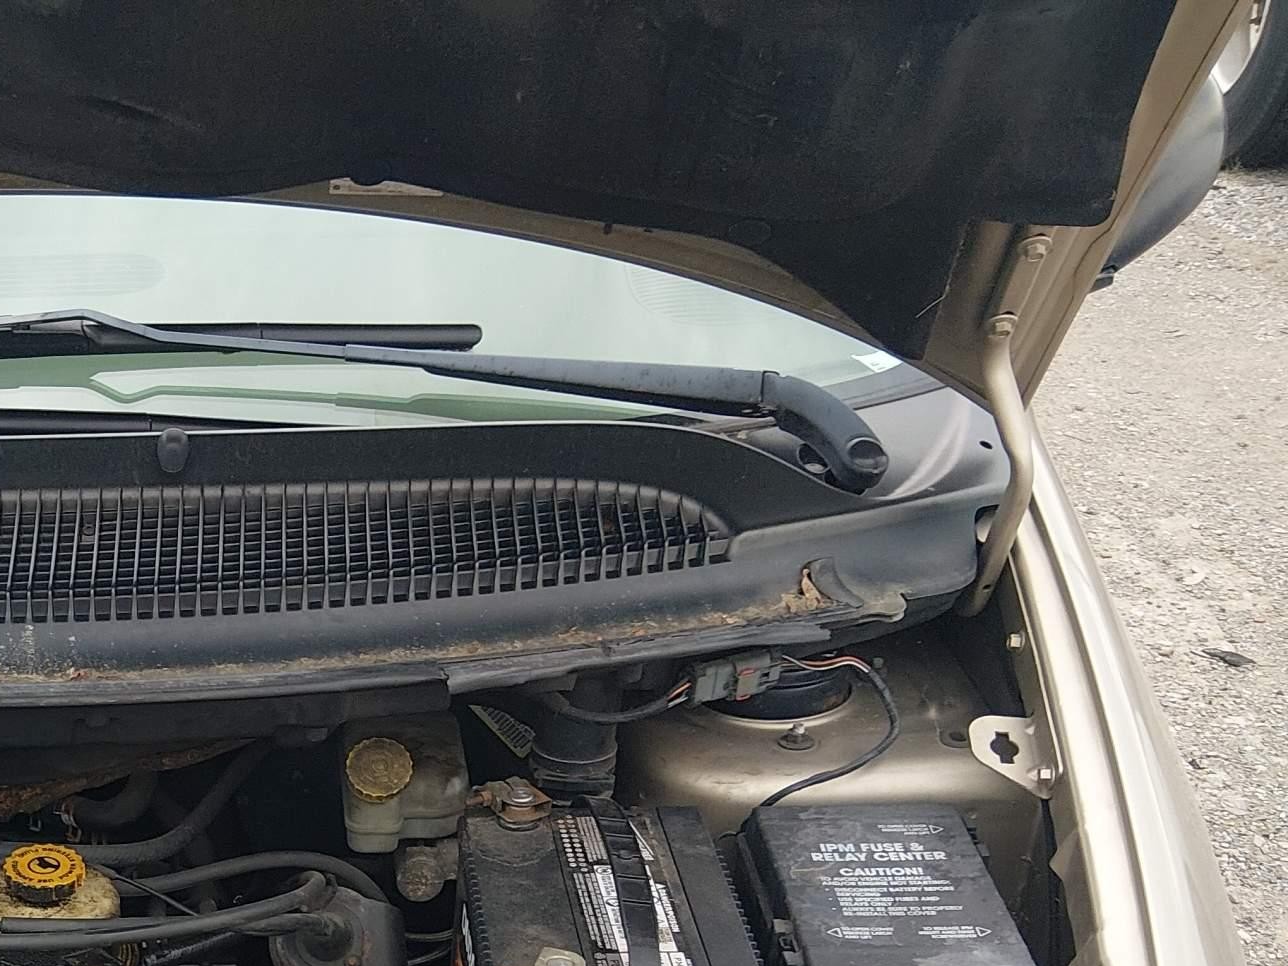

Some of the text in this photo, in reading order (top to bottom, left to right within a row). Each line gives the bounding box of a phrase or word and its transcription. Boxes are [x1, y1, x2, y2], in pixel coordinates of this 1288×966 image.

[819, 843, 924, 852] IPM FUSE &
[811, 851, 948, 862] RELAY CENTER
[839, 867, 924, 876] CAUTION!
